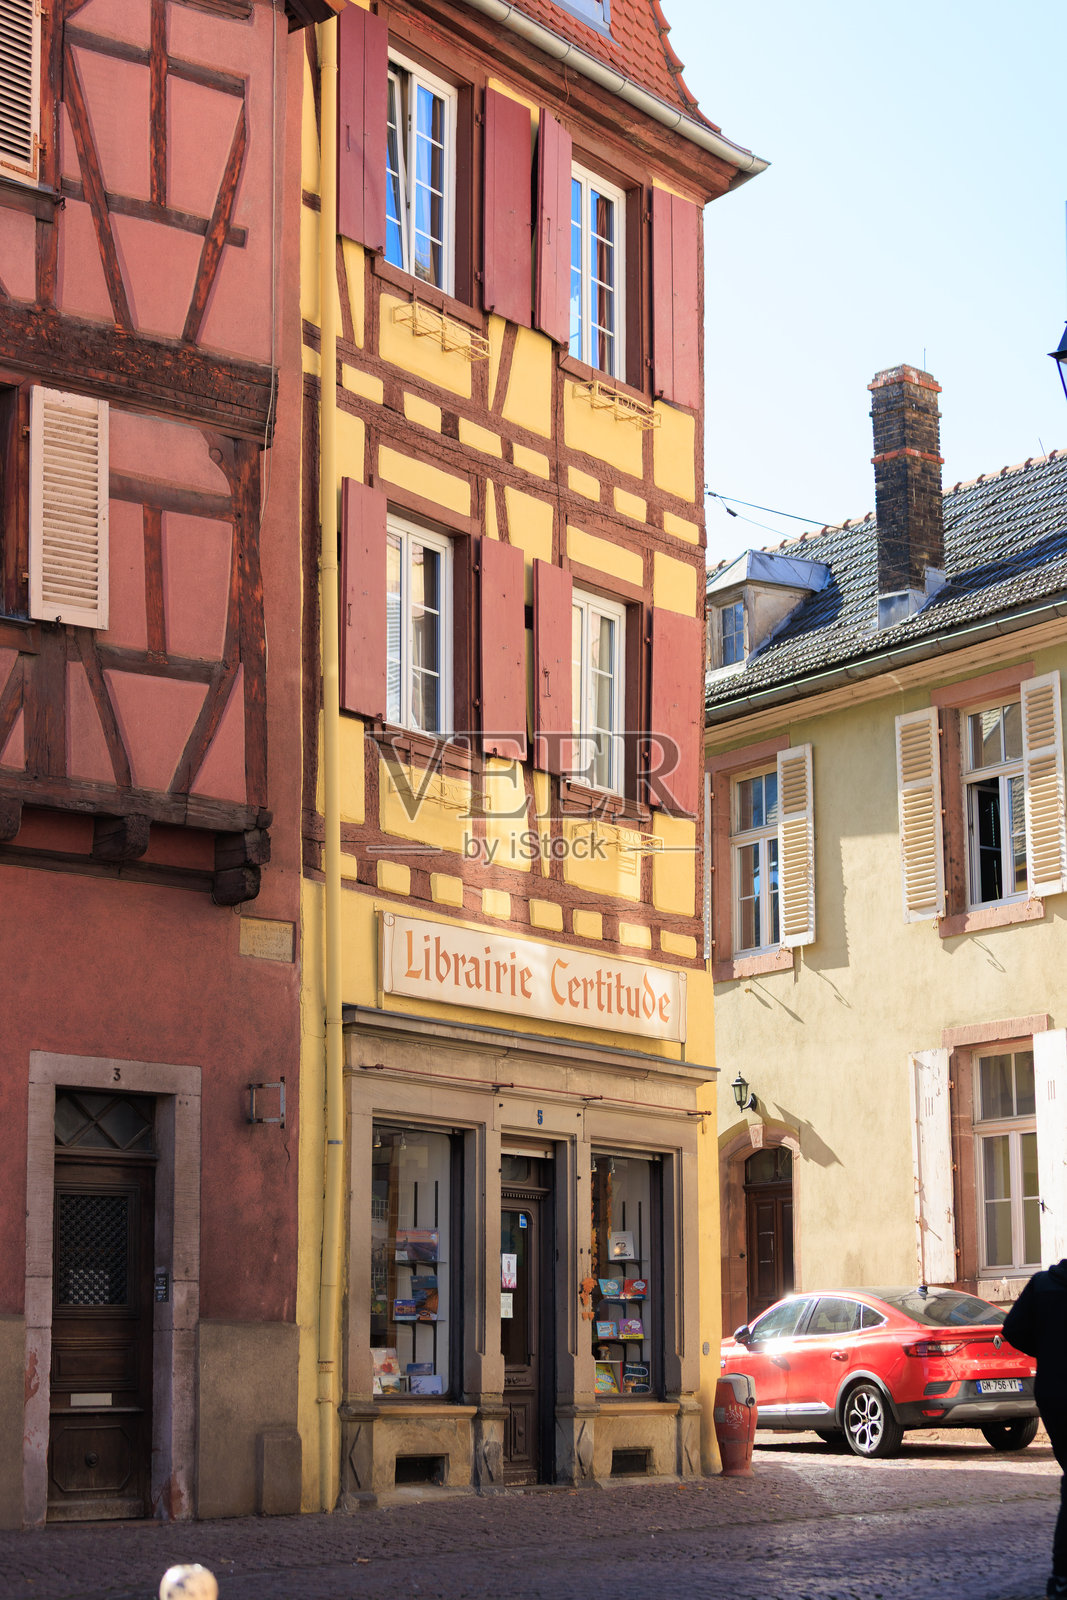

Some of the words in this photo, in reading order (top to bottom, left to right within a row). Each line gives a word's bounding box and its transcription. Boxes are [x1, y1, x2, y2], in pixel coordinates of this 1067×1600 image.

[404, 930, 533, 999] Librairie
[551, 958, 671, 1023] Certitude
[114, 1067, 121, 1081] 3
[537, 1109, 543, 1125] 5
